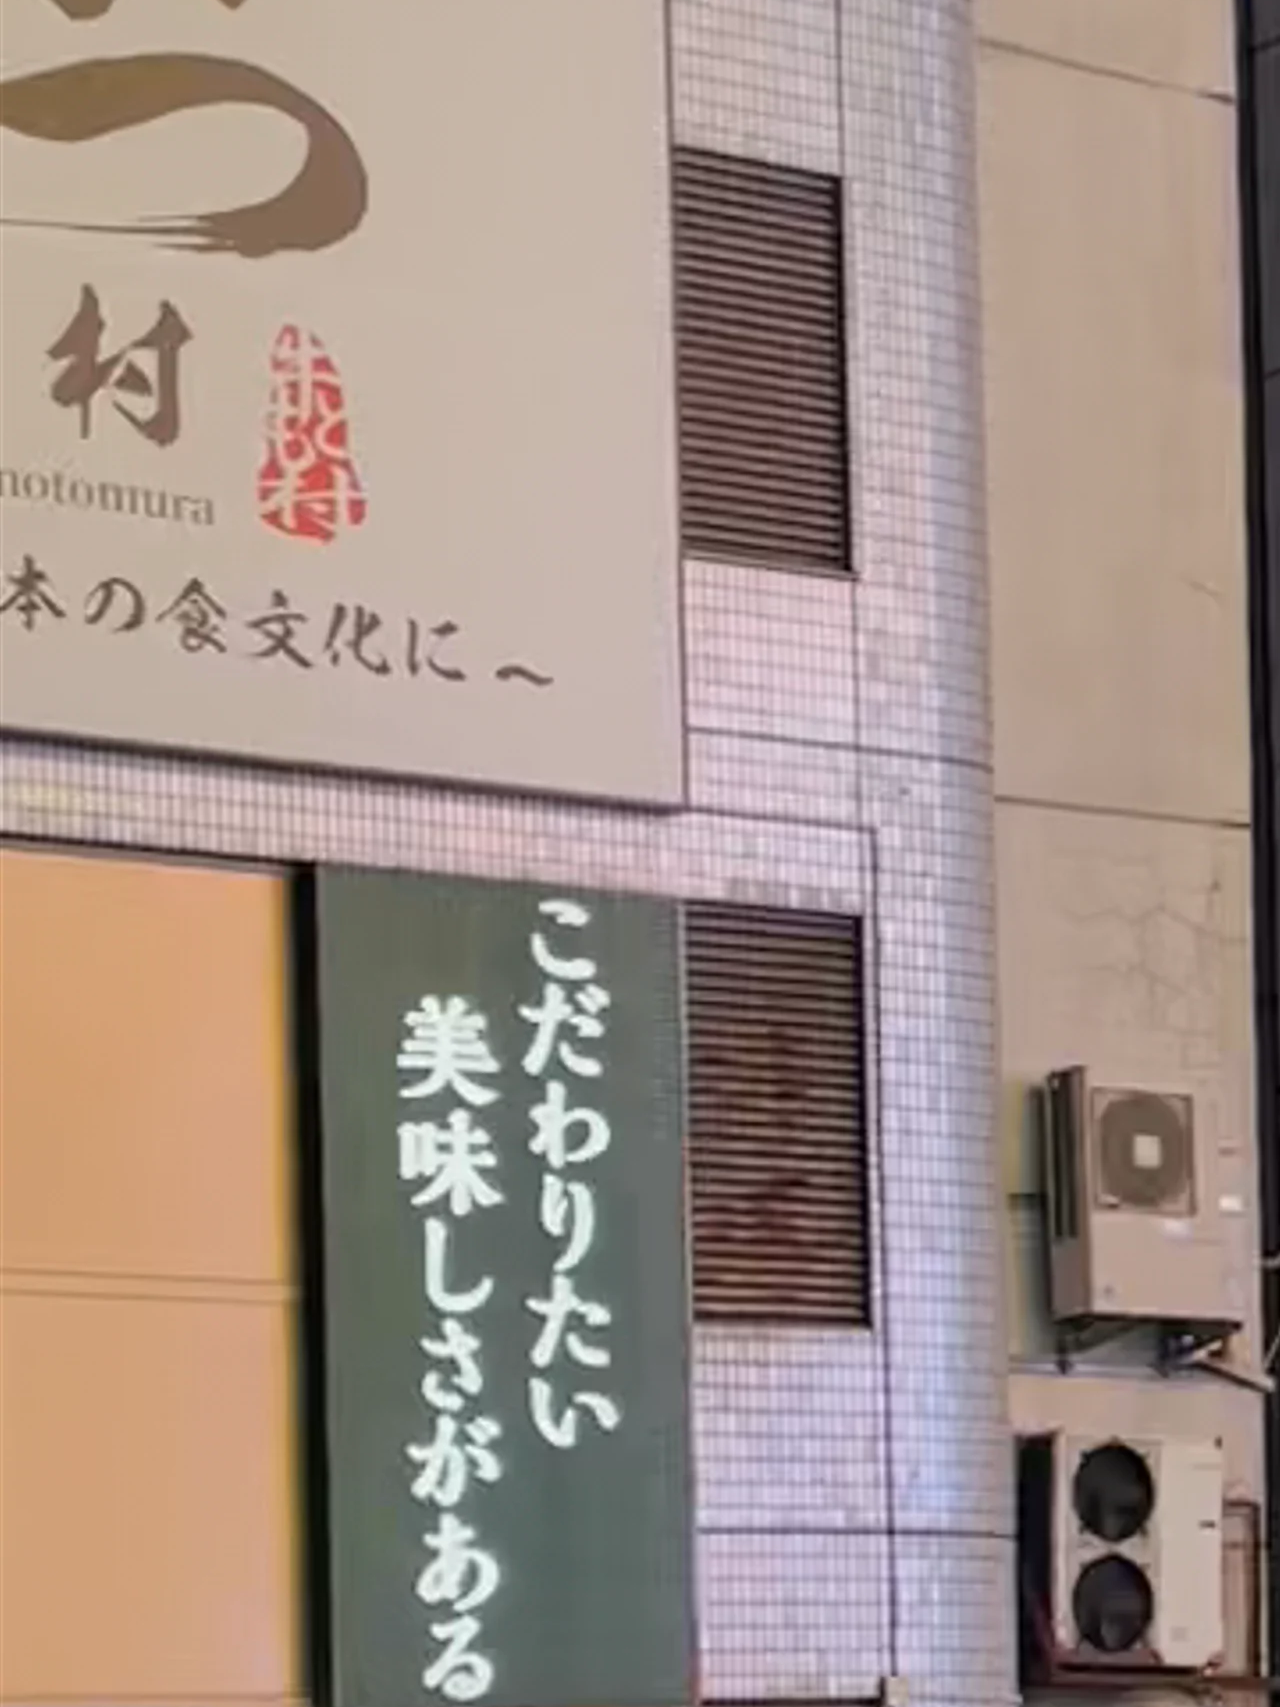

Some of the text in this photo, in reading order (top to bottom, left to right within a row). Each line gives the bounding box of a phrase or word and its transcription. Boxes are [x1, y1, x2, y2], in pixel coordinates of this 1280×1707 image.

[45, 283, 194, 449] 村
[397, 994, 504, 1703] 美味しさがある
[519, 898, 620, 1450] こだわりたい
